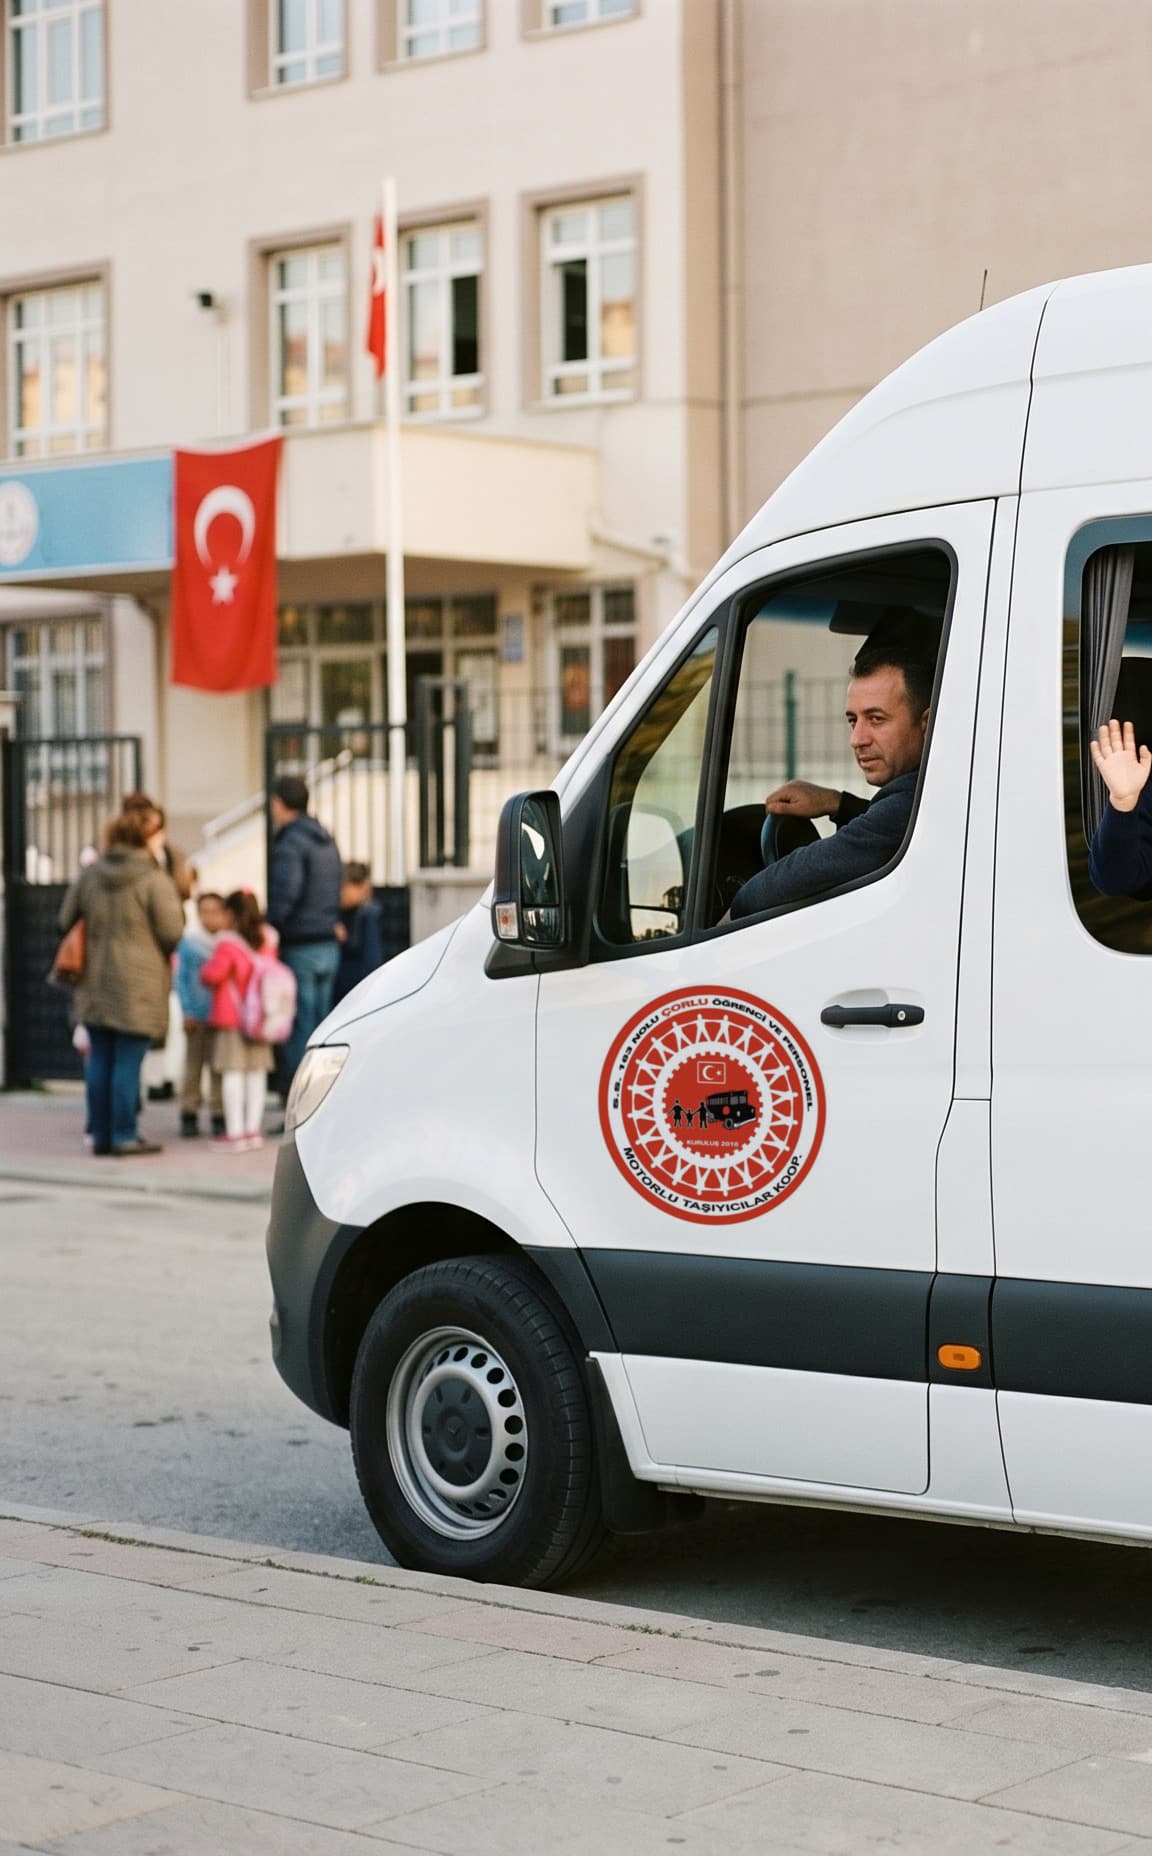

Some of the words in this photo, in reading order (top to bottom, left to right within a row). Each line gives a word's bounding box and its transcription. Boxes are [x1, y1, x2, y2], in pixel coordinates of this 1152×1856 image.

[612, 1078, 623, 1110] S.S.
[632, 1015, 660, 1044] NOLU
[661, 998, 709, 1017] ÇORLU
[712, 998, 768, 1022] ÖĞRENCİ
[769, 1020, 783, 1035] VE
[782, 1035, 814, 1112] PERSONEL
[623, 1147, 679, 1203] MOTORLU
[683, 1191, 774, 1213] TAŞIYICILAR
[773, 1154, 803, 1193] KOOP.
